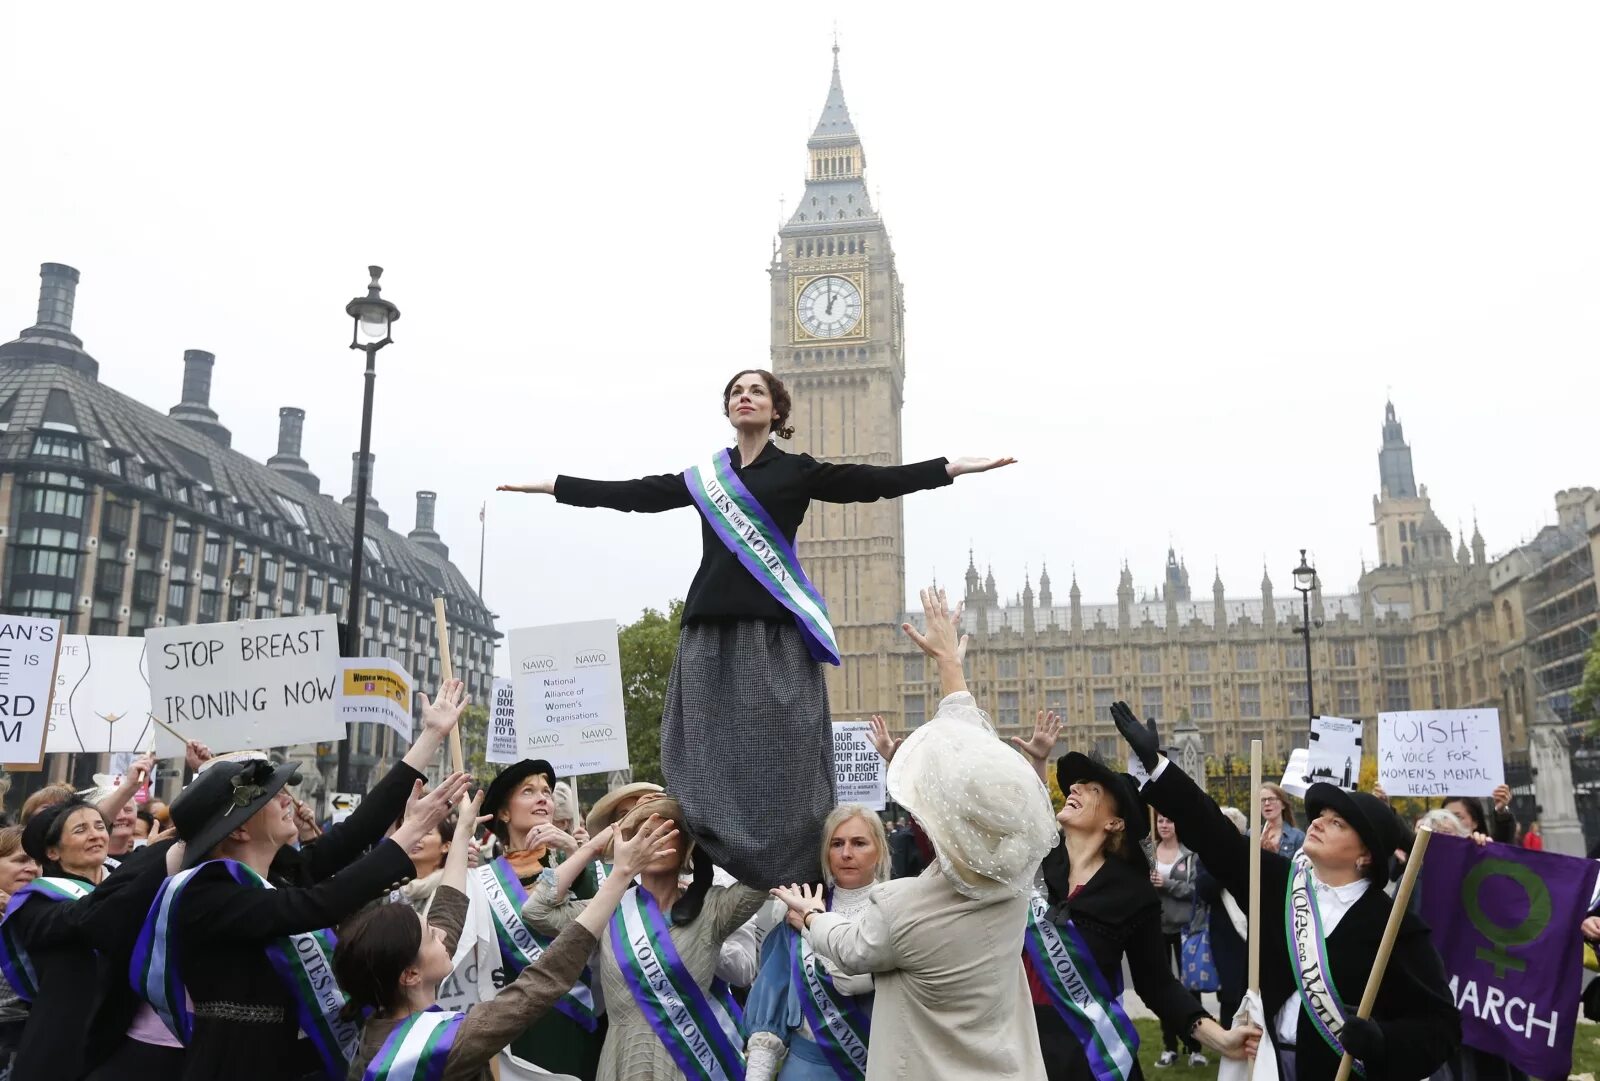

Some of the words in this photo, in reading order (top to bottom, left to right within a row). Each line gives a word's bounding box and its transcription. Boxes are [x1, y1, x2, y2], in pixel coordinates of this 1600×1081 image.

[706, 480, 733, 514] OTES
[729, 512, 745, 529] FOR
[743, 525, 789, 583] WOMEN
[163, 639, 224, 670] STOP
[241, 629, 326, 661] BREAST
[23, 653, 39, 666] IS
[522, 659, 554, 671] NAWO
[575, 653, 607, 665] NAWO
[543, 676, 576, 687] National
[164, 687, 268, 724] IRONING
[284, 674, 337, 707] NOW
[544, 690, 575, 699] Alliance
[576, 688, 585, 696] of
[360, 705, 380, 713] TIME
[545, 700, 582, 711] Women's
[496, 707, 515, 718] OUR
[546, 711, 599, 724] Organisations
[494, 717, 513, 728] OUR
[494, 726, 506, 736] TO
[581, 727, 613, 740] NAWO
[834, 732, 852, 742] OUR
[1393, 720, 1468, 743] WISH
[528, 733, 560, 745] NAWO
[834, 742, 867, 751] BODIES
[834, 753, 852, 762] OUR
[855, 752, 880, 761] LIVES
[1385, 751, 1395, 763] A
[1402, 748, 1436, 763] VOICE
[1447, 750, 1478, 762] FOR
[855, 763, 881, 773] RIGHT
[1381, 767, 1436, 780] WOMEN'S
[1443, 767, 1493, 781] MENTAL
[848, 772, 879, 782] DECIDE
[1408, 783, 1449, 795] HEALTH
[497, 900, 509, 916] FOR
[505, 914, 541, 961] WOME
[1040, 920, 1054, 940] FOR
[1049, 940, 1093, 1008] WOMEN
[297, 937, 332, 991] OTES
[322, 990, 339, 1015] FOR
[803, 952, 832, 1011] VOTES
[828, 1011, 843, 1031] FOR
[634, 935, 669, 992] VOTES
[663, 991, 679, 1010] FOR
[674, 1007, 719, 1073] WOMEN
